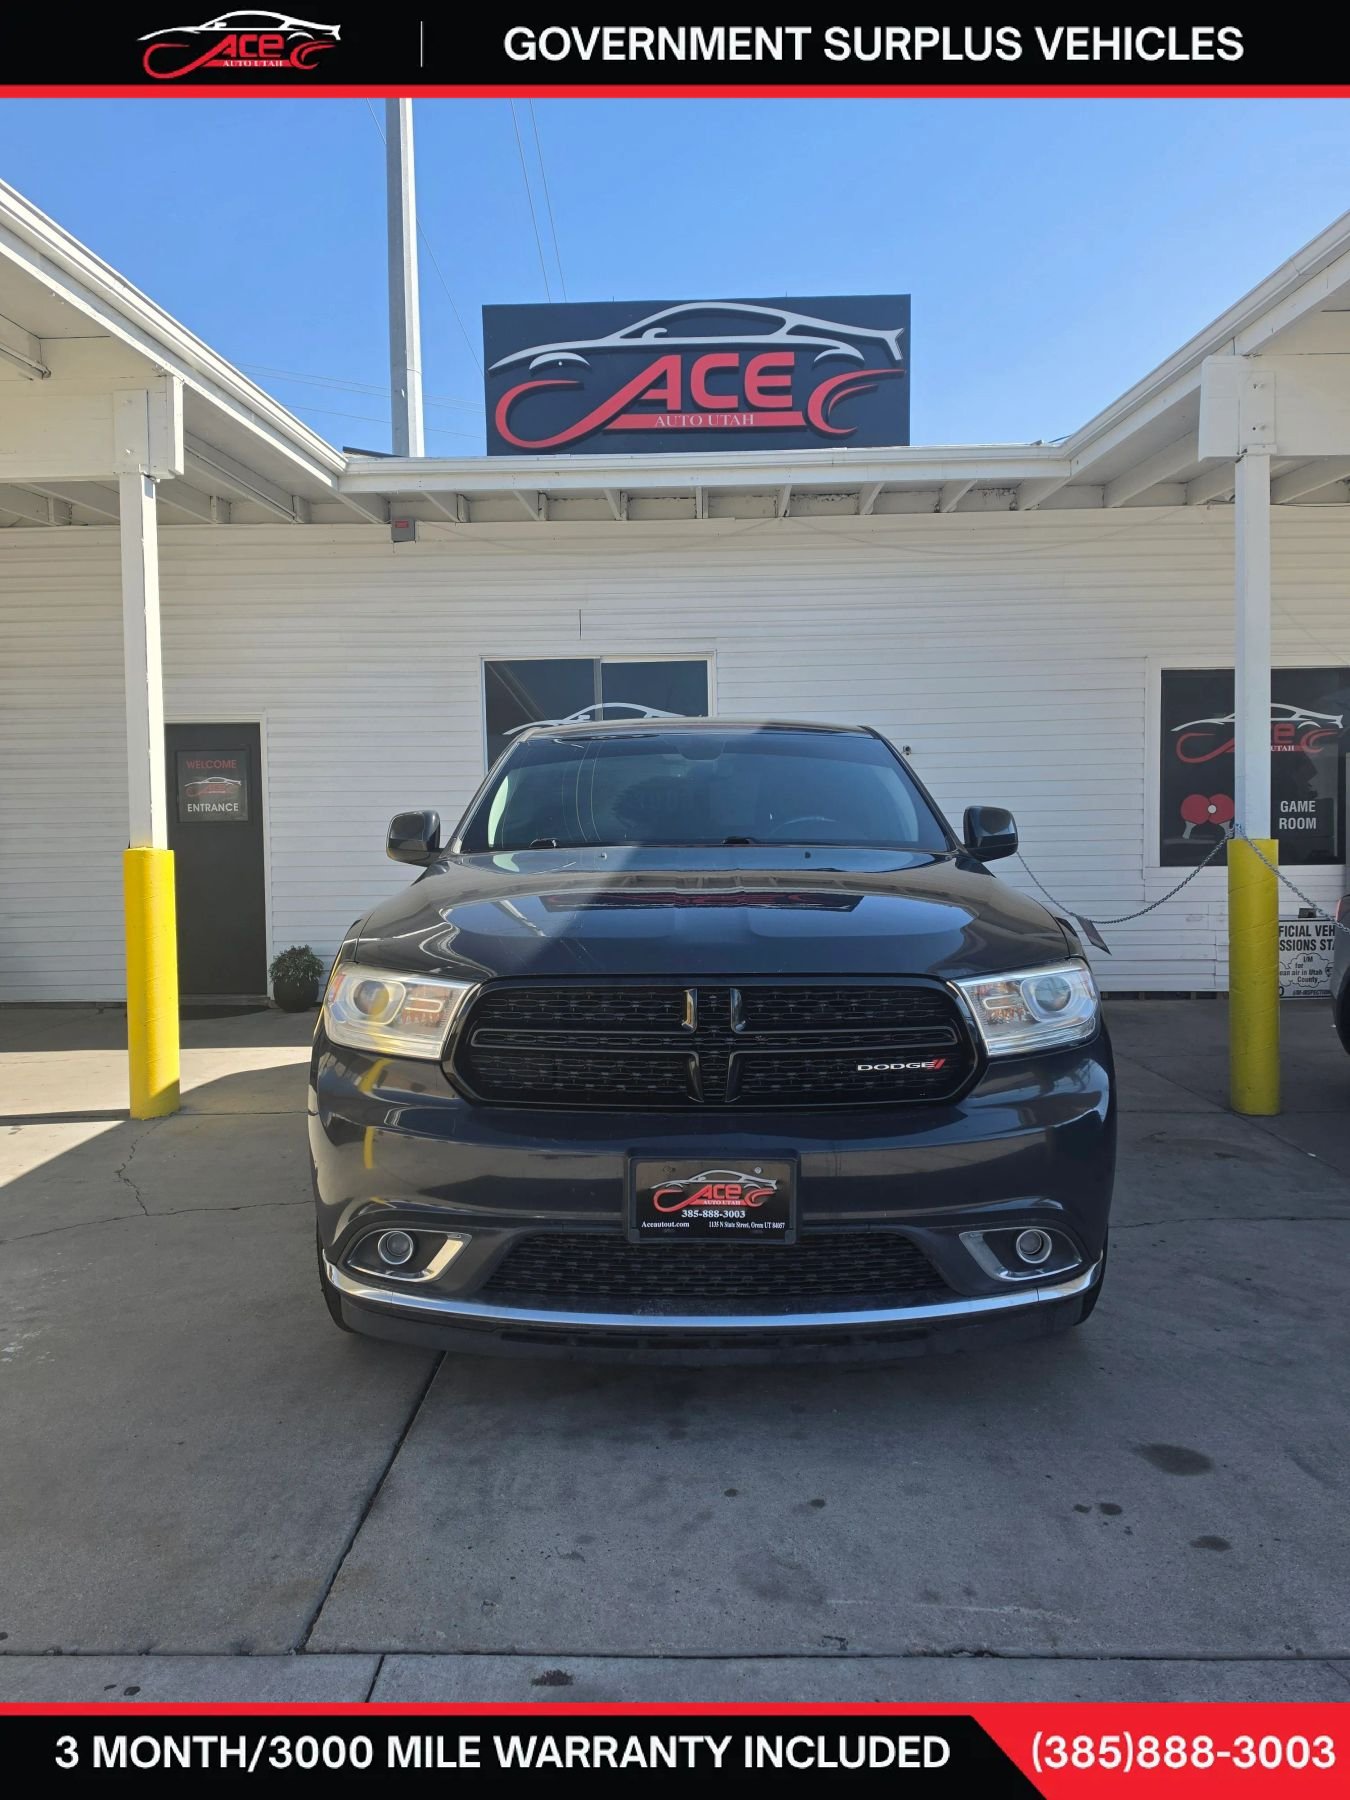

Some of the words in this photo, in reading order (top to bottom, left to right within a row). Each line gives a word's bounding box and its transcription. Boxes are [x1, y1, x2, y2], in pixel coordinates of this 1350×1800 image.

[636, 351, 796, 412] ACE
[655, 415, 703, 428] AUTO
[708, 414, 755, 427] UTAH
[186, 760, 237, 769] WELCOME
[187, 803, 239, 812] ENTRANCE
[1280, 800, 1316, 813] GAME
[1279, 818, 1317, 830] ROOM
[1279, 939, 1317, 951] SSIONS
[857, 1061, 935, 1071] DODGE
[681, 1209, 746, 1219] 385-888-3003
